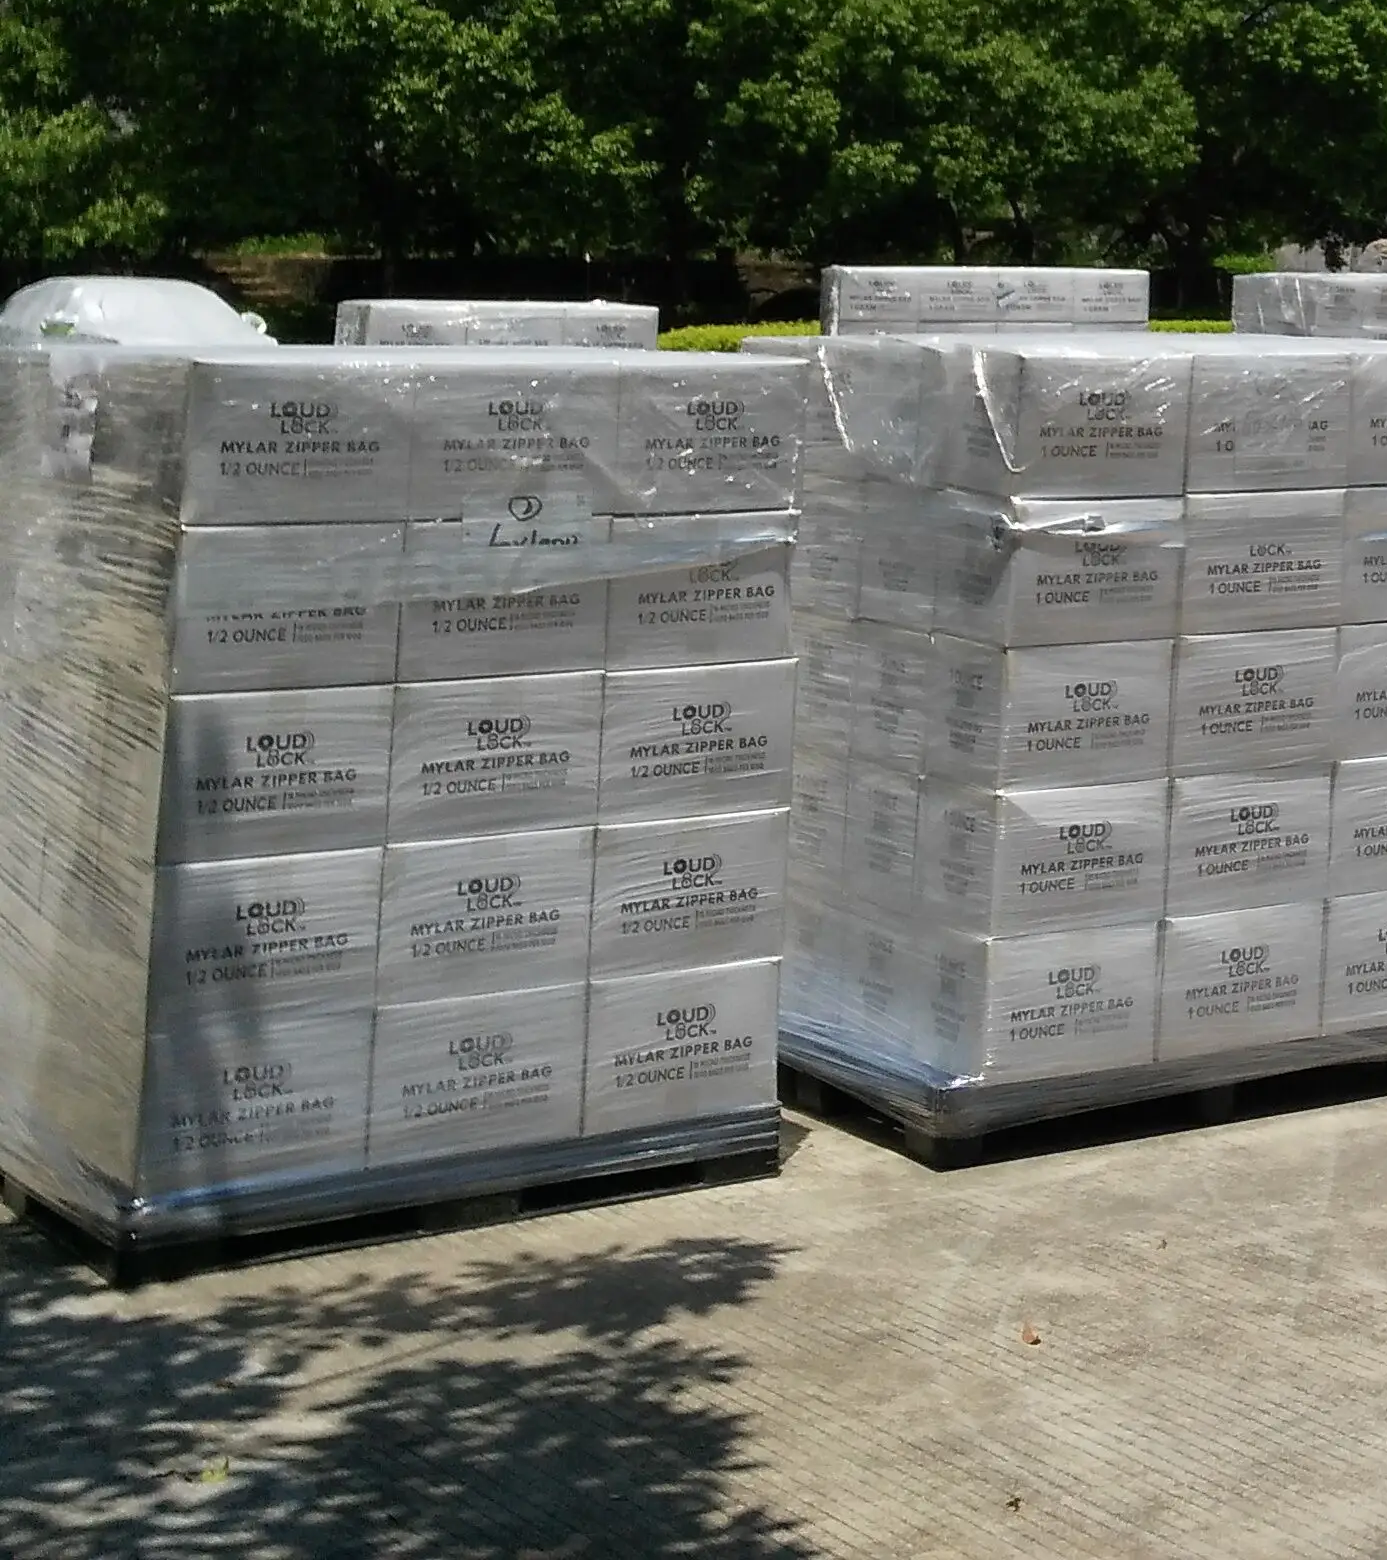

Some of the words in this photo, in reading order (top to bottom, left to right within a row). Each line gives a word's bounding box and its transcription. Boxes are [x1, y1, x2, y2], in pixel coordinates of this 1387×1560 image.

[270, 402, 330, 418] LOUD
[280, 417, 329, 434] LOCK
[220, 441, 277, 453] MYLAR
[286, 441, 340, 452] ZIPPER
[347, 441, 380, 452] BAG
[246, 462, 300, 475] OUNCE
[1249, 544, 1285, 557] LOCK
[689, 566, 731, 583] LOCK
[1207, 564, 1248, 575] MYLAR
[1254, 562, 1293, 572] ZIPPER
[1297, 558, 1320, 570] BAG
[638, 592, 686, 605] MYLAR
[694, 589, 741, 601] ZIPPER
[746, 586, 774, 598] BAG
[1209, 582, 1215, 594] 1
[1218, 580, 1260, 593] OUNCE
[660, 609, 706, 623] OUNCE
[1235, 667, 1278, 684] LOUD
[1064, 681, 1111, 699] LOUD
[1242, 681, 1277, 696] LOCK
[1073, 695, 1112, 712] LOCK
[1199, 703, 1241, 717] MYLAR
[1245, 699, 1285, 713] ZIPPER
[1290, 696, 1314, 709] BAG
[672, 704, 724, 721] LOUD
[1354, 708, 1361, 720] 1
[467, 718, 523, 737] LOUD
[682, 720, 724, 736] LOCK
[1027, 719, 1071, 733] MYLAR
[1077, 716, 1120, 730] ZIPPER
[1125, 713, 1150, 725] BAG
[1201, 723, 1208, 735] 1
[1210, 720, 1252, 734] OUNCE
[477, 736, 522, 751] LOCK
[630, 744, 679, 758] MYLAR
[685, 739, 734, 753] ZIPPER
[739, 736, 768, 748] BAG
[1027, 740, 1034, 752] 1
[1036, 736, 1081, 750] OUNCE
[421, 760, 474, 775] MYLAR
[481, 755, 534, 769] ZIPPER
[540, 751, 570, 764] BAG
[631, 764, 649, 778] 1/2
[653, 761, 699, 776] OUNCE
[423, 782, 441, 796] 1/2
[446, 778, 496, 793] OUNCE
[663, 858, 716, 875] LOUD
[457, 877, 515, 896] LOUD
[672, 873, 715, 890] LOCK
[467, 894, 513, 913] LOCK
[621, 899, 670, 914] MYLAR
[676, 893, 724, 908] ZIPPER
[730, 888, 758, 902] BAG
[411, 921, 464, 936] MYLAR
[471, 915, 522, 930] ZIPPER
[529, 909, 560, 923] BAG
[622, 921, 640, 934] 1/2
[643, 916, 690, 931] OUNCE
[411, 944, 431, 958] 1/2
[436, 939, 484, 955] OUNCE
[1048, 967, 1095, 984] LOUD
[1346, 961, 1386, 976] MYLAR
[1057, 982, 1094, 1000] LOCK
[1347, 982, 1353, 994] 1
[657, 1006, 709, 1026] LOUD
[1010, 1007, 1055, 1023] MYLAR
[1059, 1001, 1104, 1016] ZIPPER
[1108, 997, 1133, 1009] BAG
[666, 1024, 710, 1041] LOCK
[1010, 1028, 1016, 1041] 1
[1018, 1023, 1065, 1039] OUNCE
[614, 1050, 666, 1066] MYLAR
[670, 1042, 719, 1059] ZIPPER
[724, 1036, 752, 1052] BAG
[616, 1073, 634, 1088] 1/2
[638, 1067, 684, 1084] OUNCE
